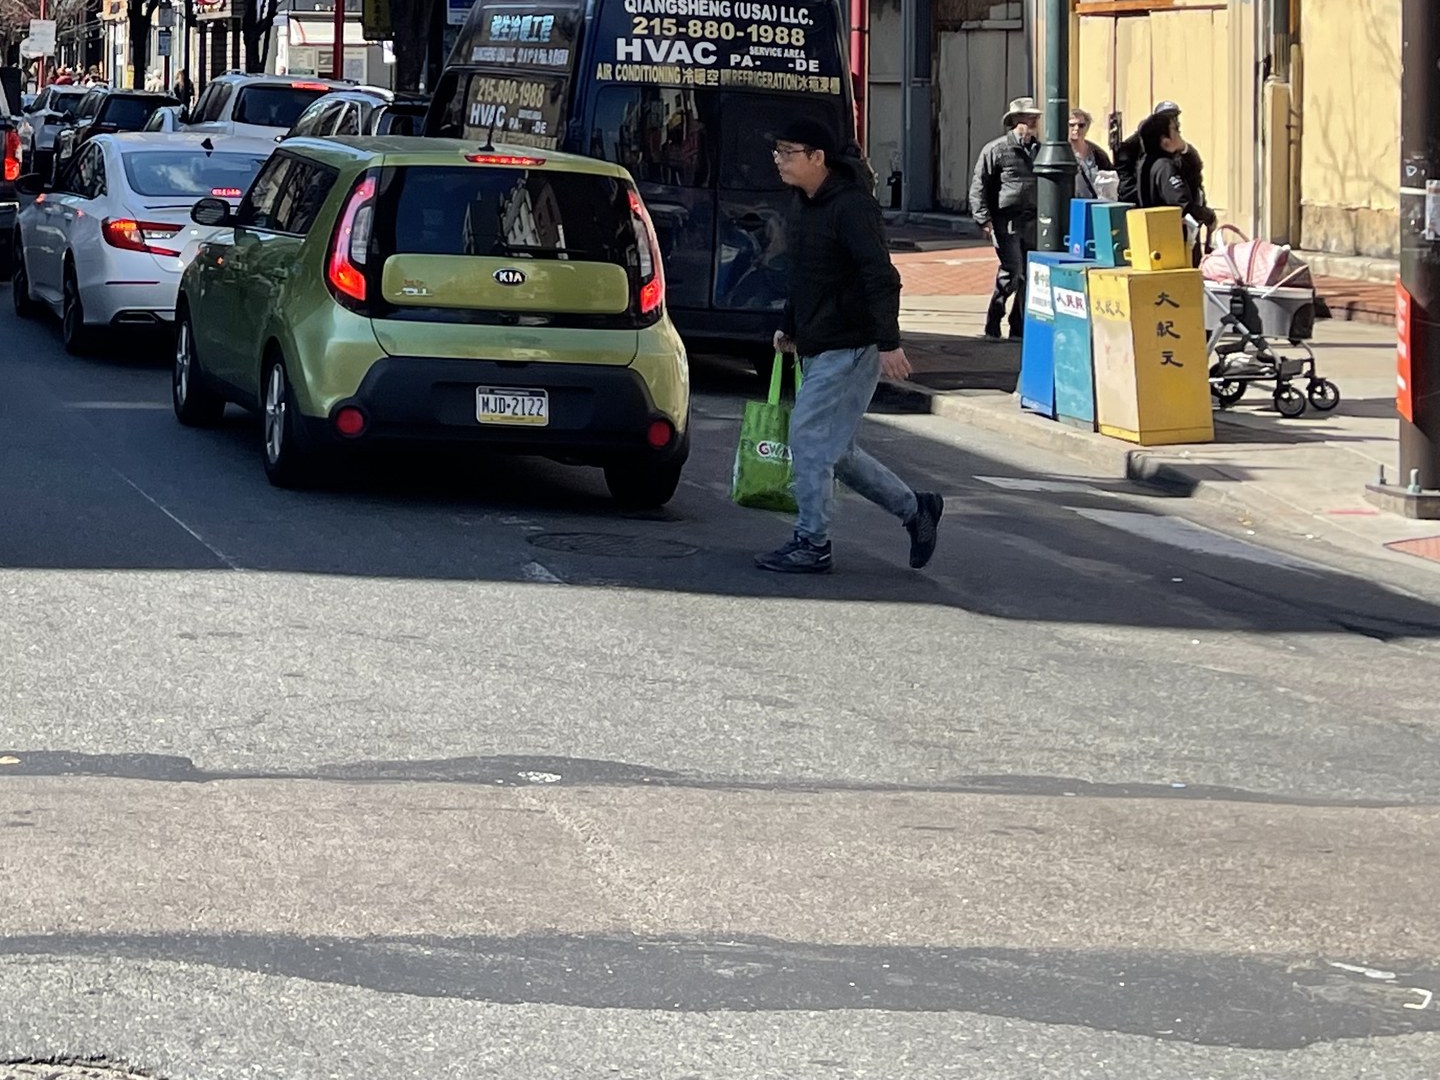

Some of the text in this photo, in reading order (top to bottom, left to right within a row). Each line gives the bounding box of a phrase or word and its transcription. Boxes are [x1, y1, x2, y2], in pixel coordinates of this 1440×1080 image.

[734, 1, 778, 22] (USA)
[780, 6, 814, 26] LLC.
[632, 16, 806, 47] 215-880-1988
[616, 37, 718, 65] HVAC
[749, 45, 806, 59] SERVICE AREA
[596, 62, 613, 80] AIR
[615, 63, 681, 85] CONDITIONING
[476, 77, 546, 108] 215-880-1988
[469, 102, 507, 127] HVAC
[499, 271, 523, 282] KIA
